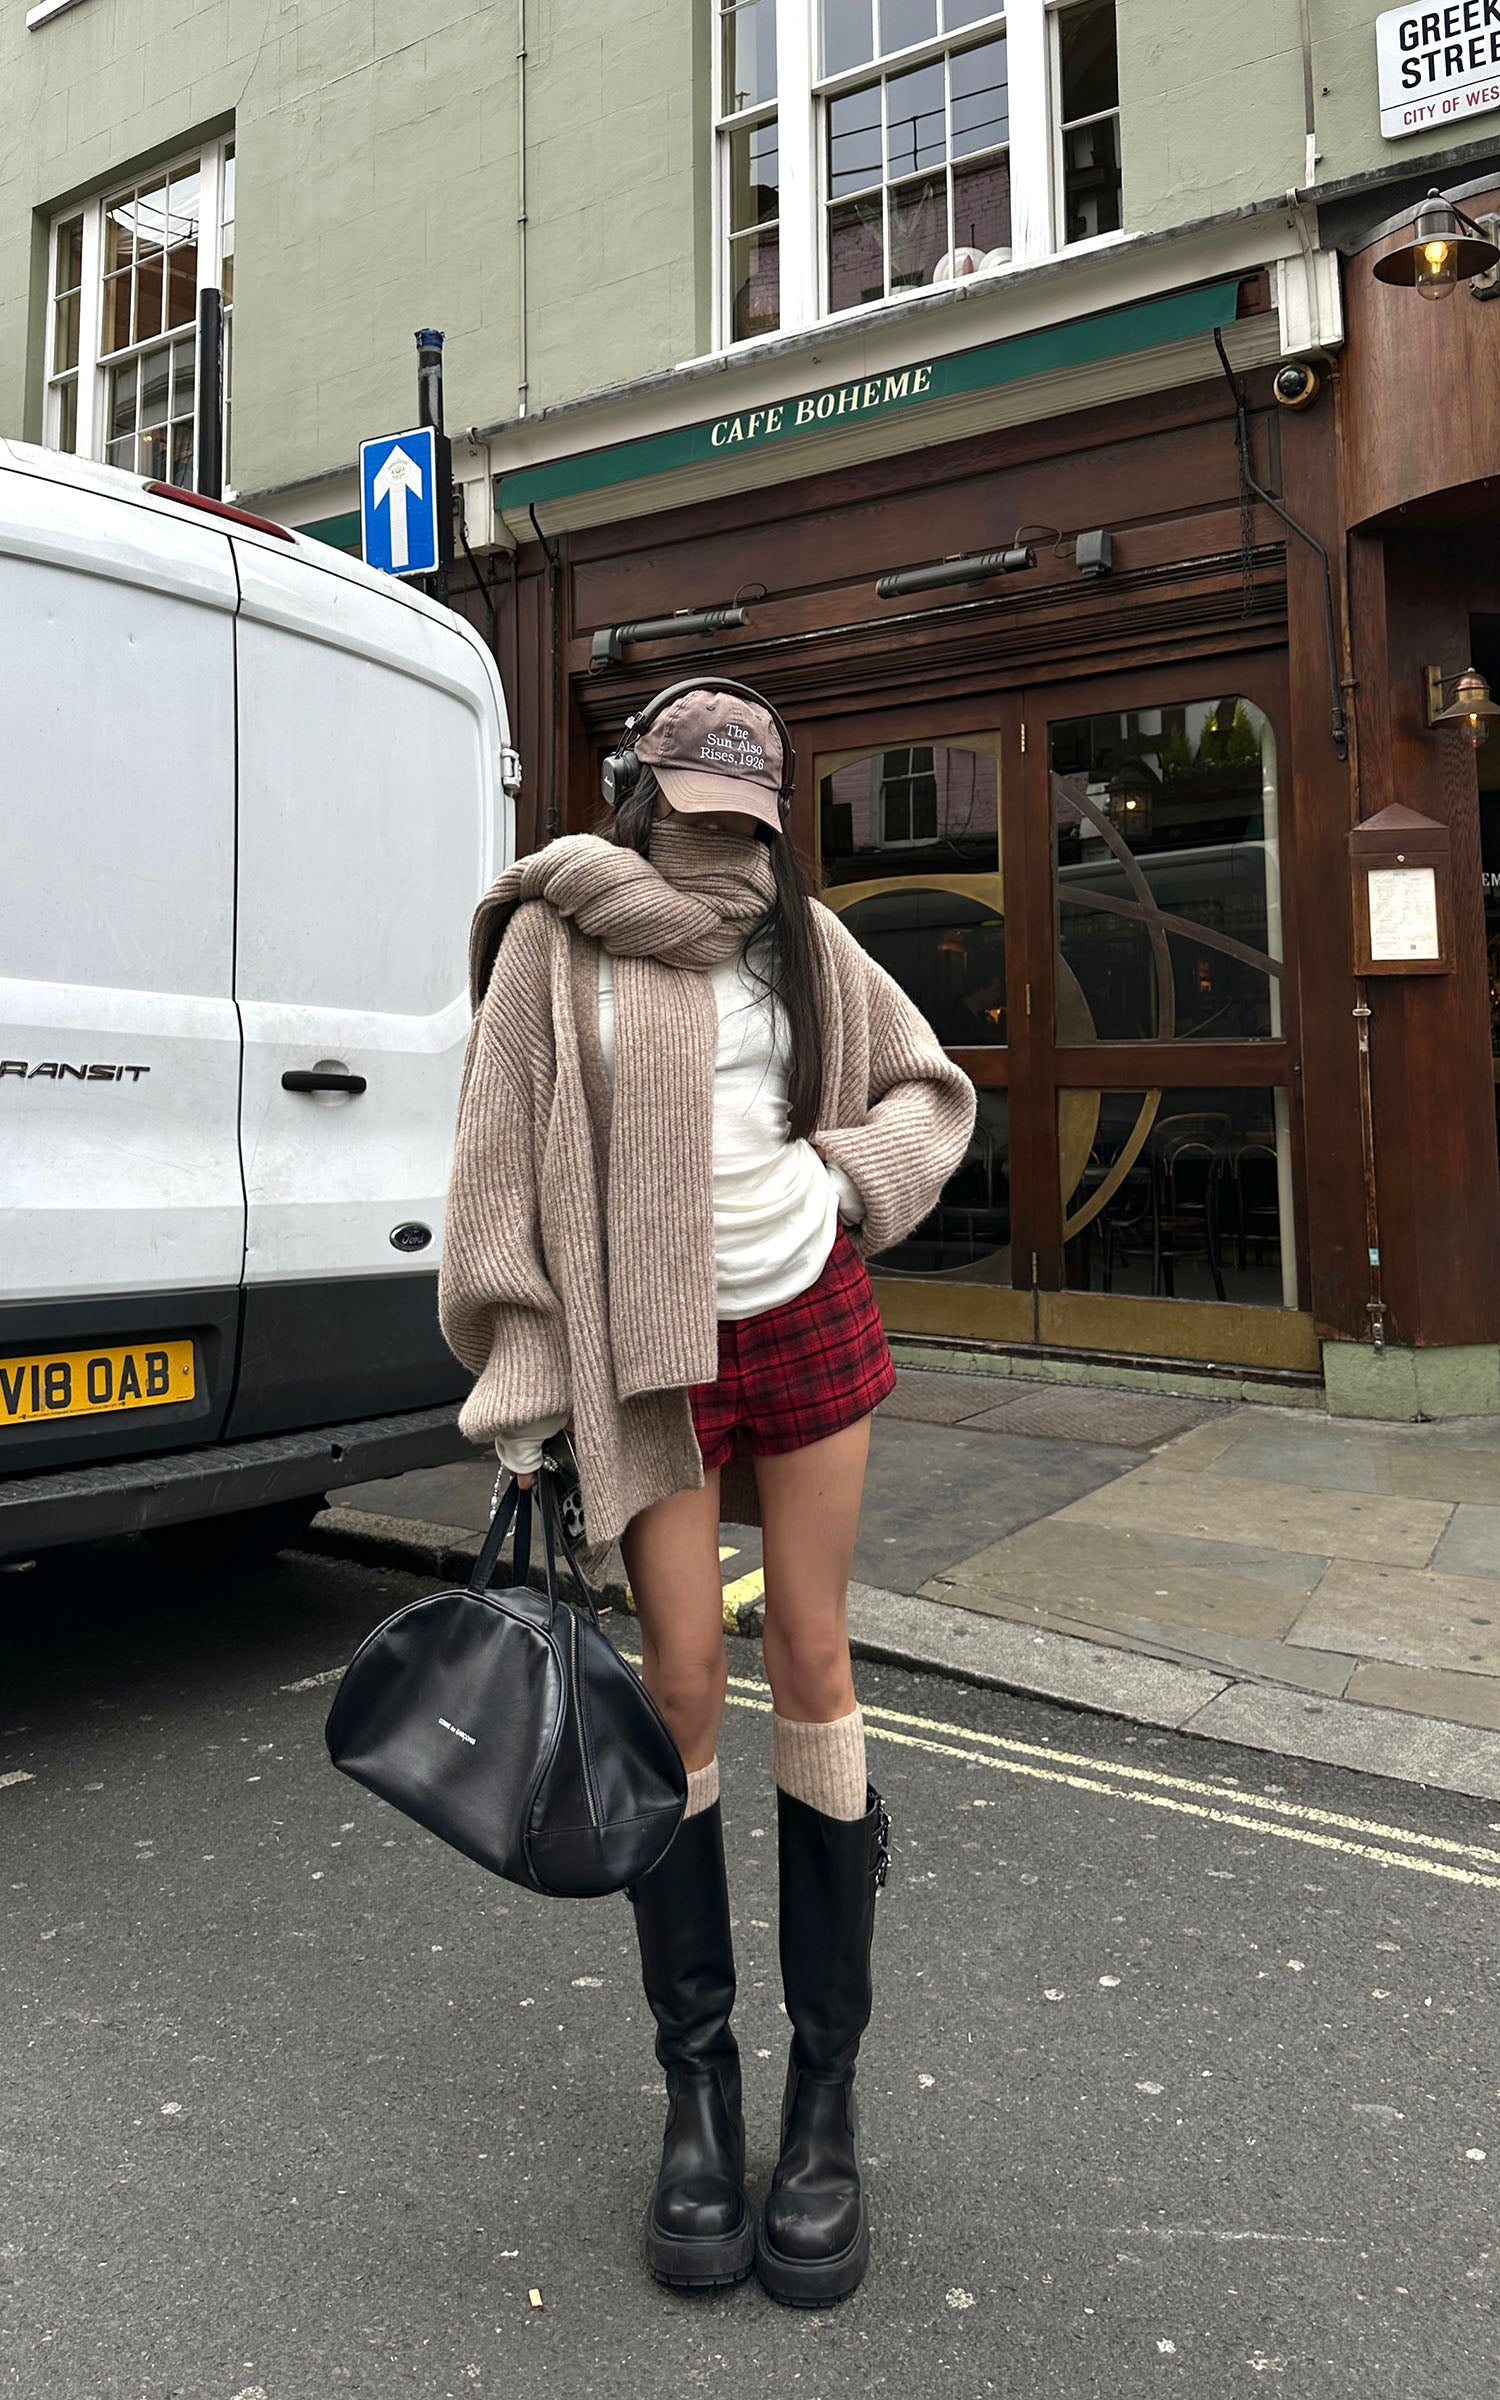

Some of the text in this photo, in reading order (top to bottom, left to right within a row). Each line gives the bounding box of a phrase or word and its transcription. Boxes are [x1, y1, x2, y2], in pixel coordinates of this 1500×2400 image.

[1400, 0, 1500, 51] GREEK
[1403, 104, 1436, 125] CITY
[1442, 97, 1460, 114] OF
[711, 366, 933, 447] CAFE BOHEME
[707, 733, 763, 755] Sun Also
[725, 724, 749, 739] The
[0, 1060, 151, 1082] RANSIT
[87, 1351, 170, 1404] OAB
